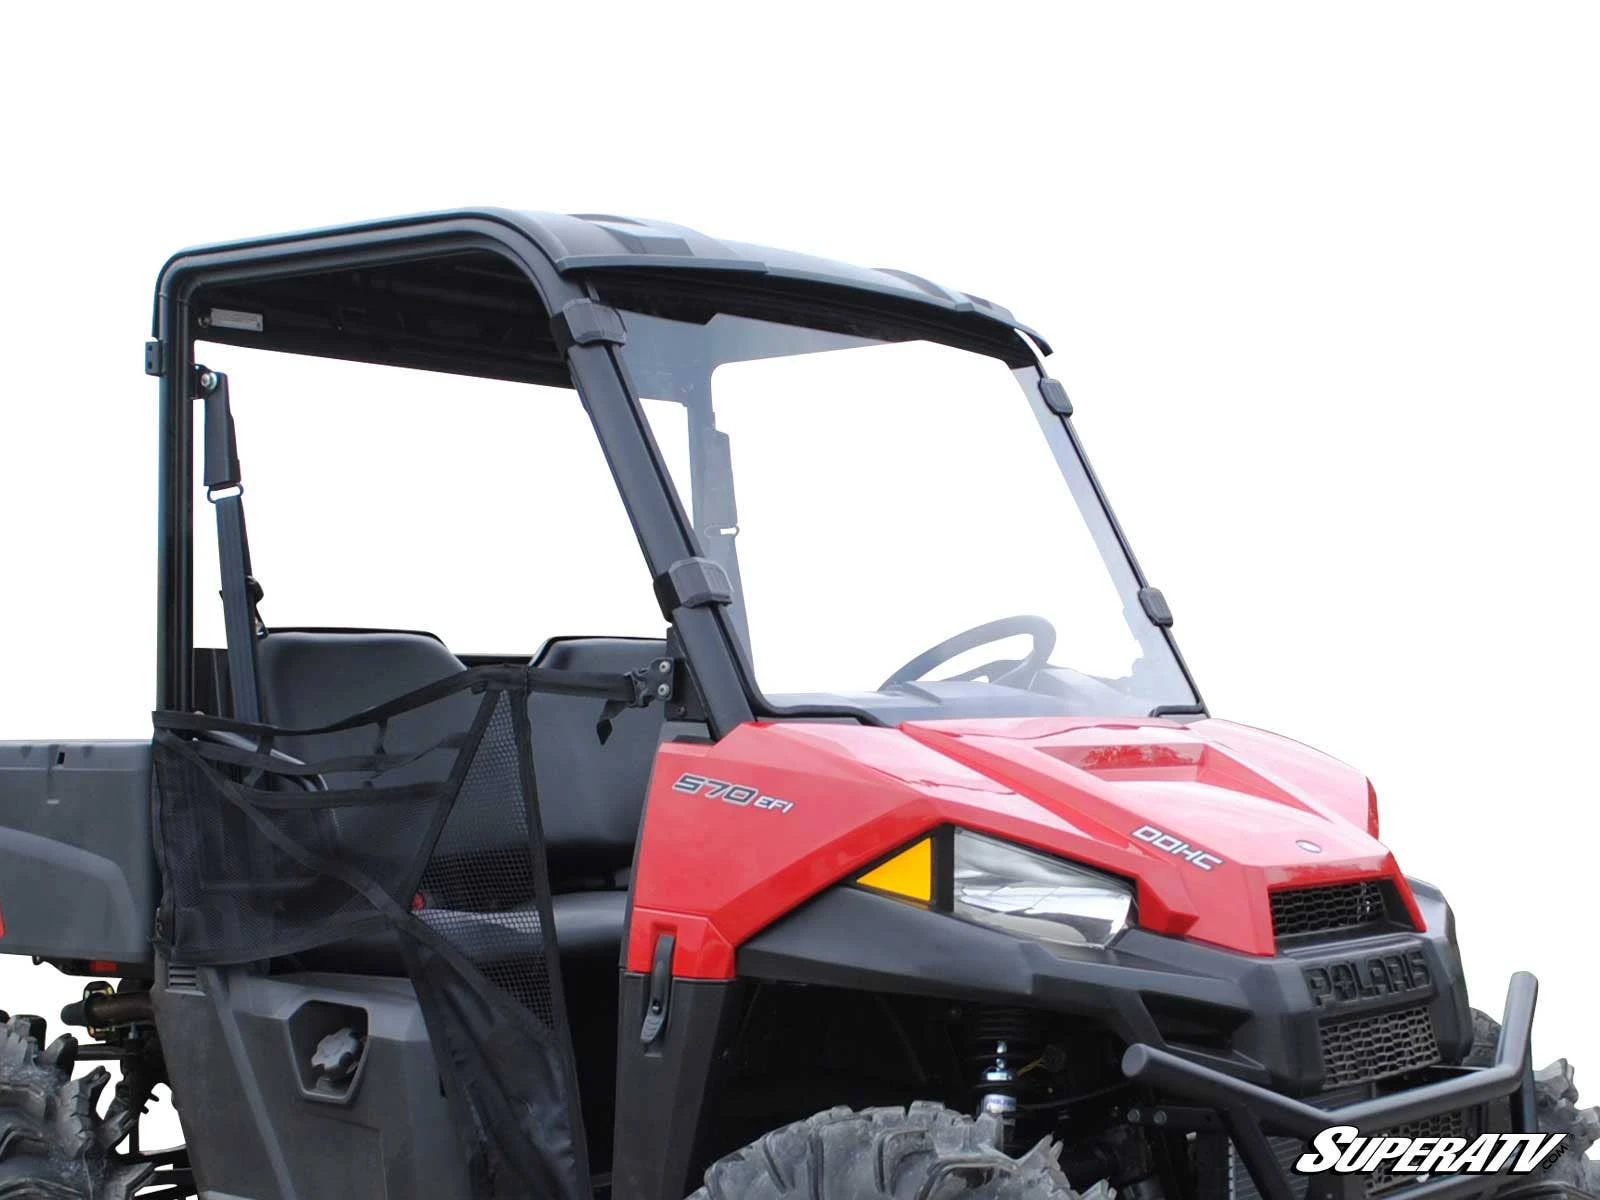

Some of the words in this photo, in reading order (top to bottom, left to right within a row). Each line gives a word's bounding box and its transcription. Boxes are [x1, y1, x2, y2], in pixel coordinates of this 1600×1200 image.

[672, 773, 758, 806] 570
[753, 796, 794, 813] EFI
[1131, 824, 1223, 871] DOHC
[1303, 951, 1432, 1008] POLARIS
